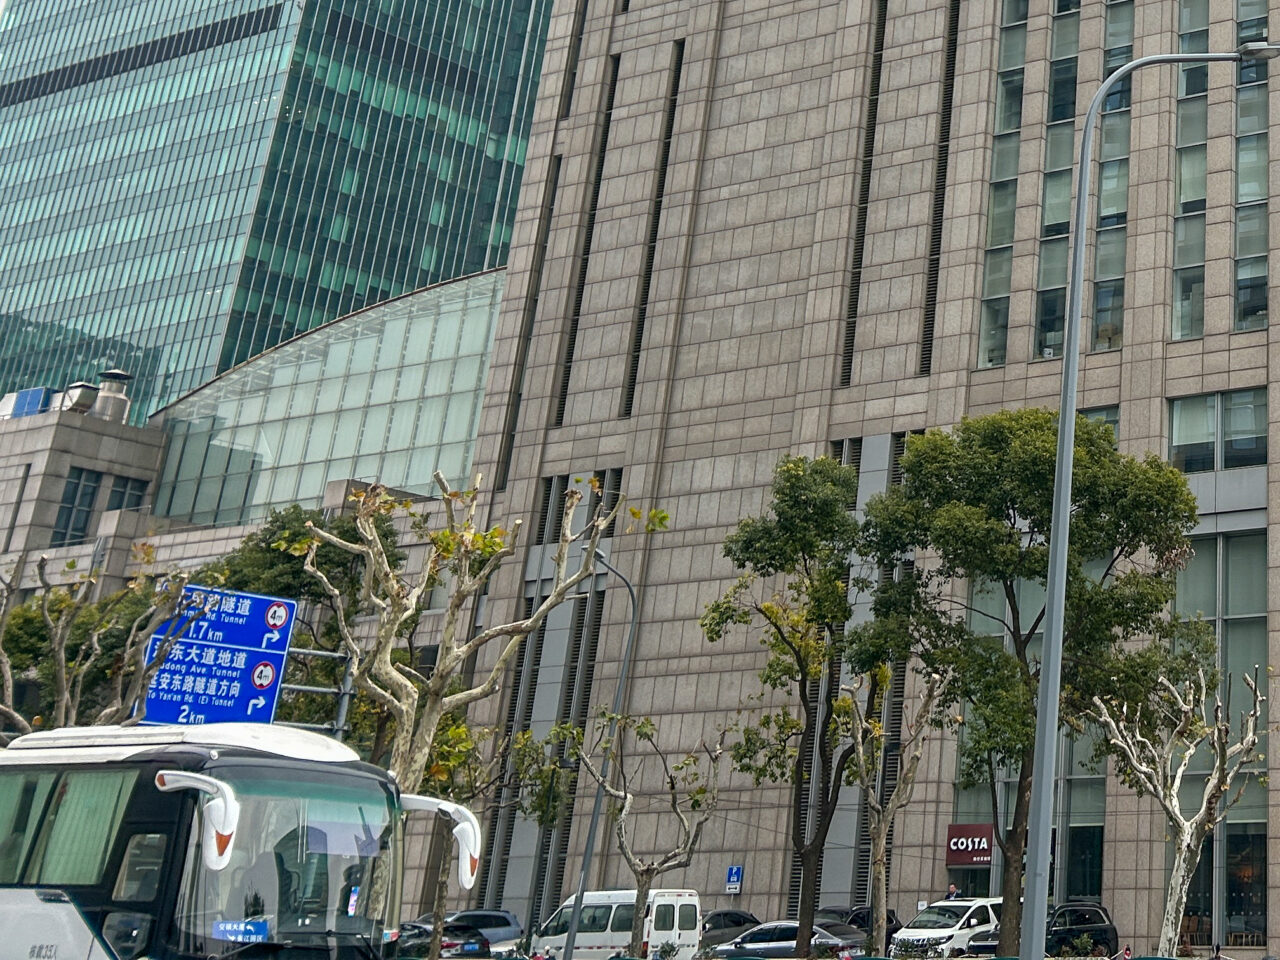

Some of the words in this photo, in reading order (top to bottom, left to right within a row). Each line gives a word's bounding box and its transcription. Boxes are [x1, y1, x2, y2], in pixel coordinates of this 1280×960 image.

[220, 613, 246, 625] Tunnel
[270, 610, 283, 622] 4m
[212, 667, 240, 678] Tunnel
[257, 669, 270, 681] 4m
[148, 690, 156, 699] To
[159, 691, 181, 702] Yan'an
[198, 695, 208, 704] (E)
[211, 697, 234, 707] Tunnel
[950, 837, 988, 851] COSTA
